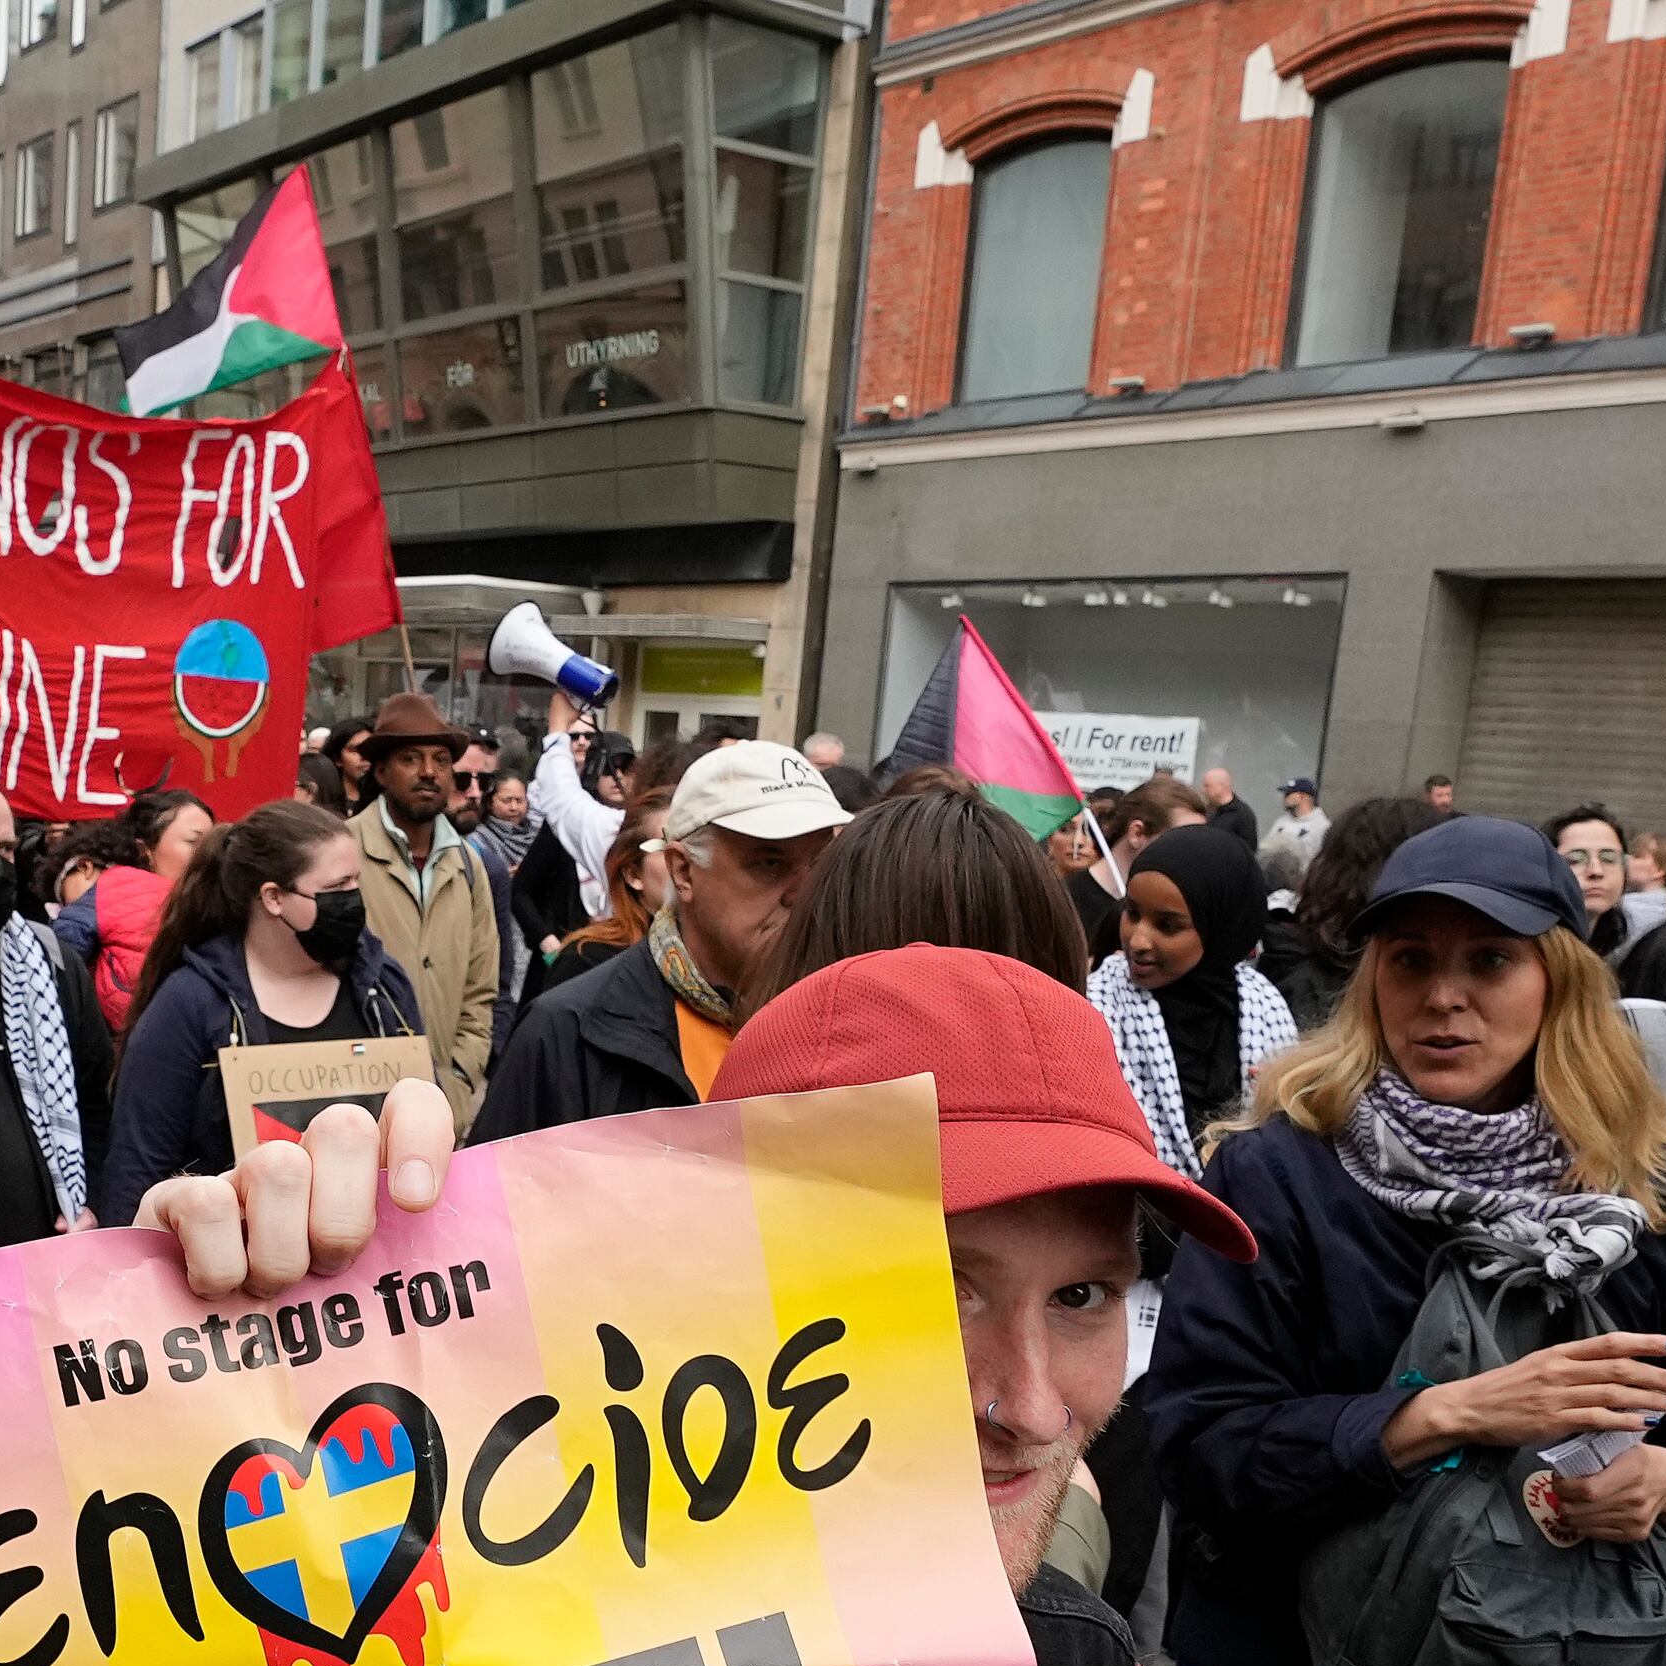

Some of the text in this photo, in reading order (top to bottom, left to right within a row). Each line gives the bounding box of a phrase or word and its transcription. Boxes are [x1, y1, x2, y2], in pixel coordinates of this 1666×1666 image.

[169, 427, 311, 589] FOR
[1087, 727, 1126, 750] For
[1130, 730, 1186, 754] rent!
[247, 1061, 403, 1095] OCCUPATION
[53, 1259, 491, 1408] No stage for
